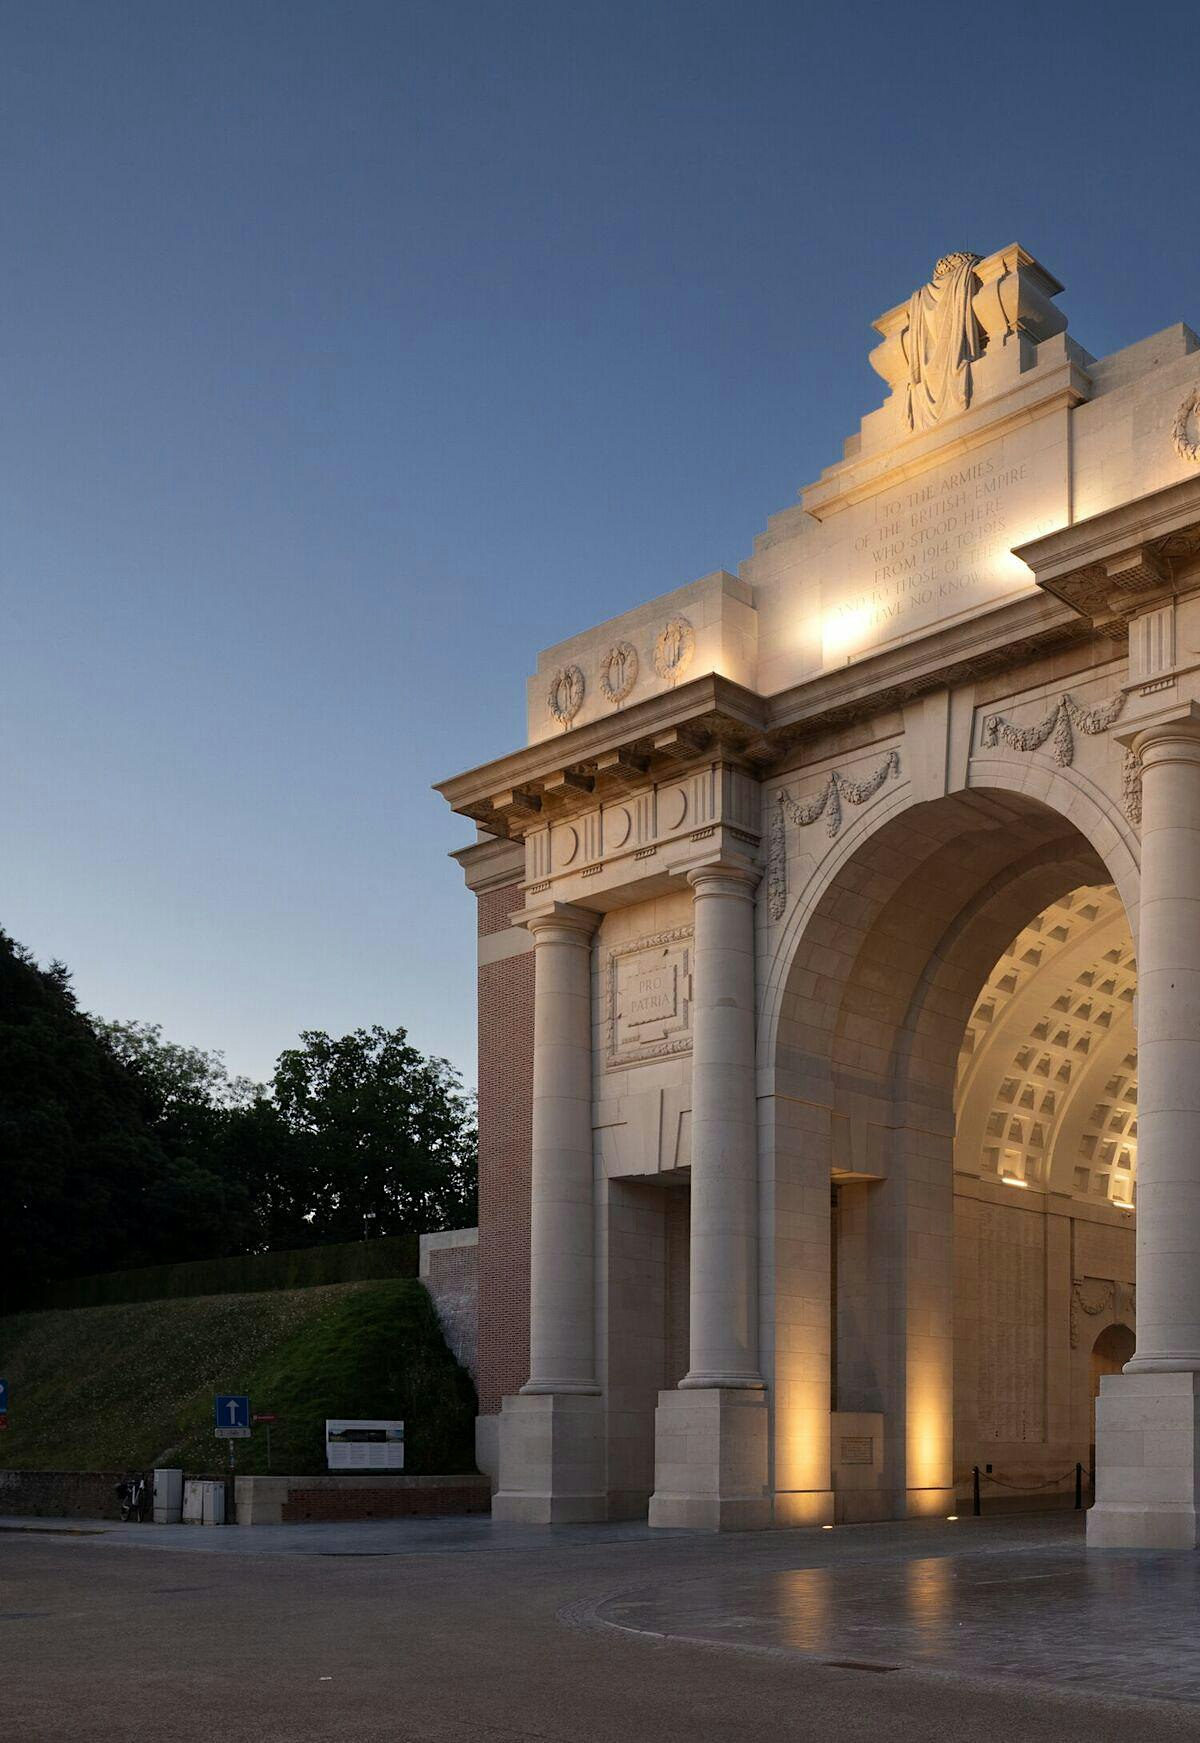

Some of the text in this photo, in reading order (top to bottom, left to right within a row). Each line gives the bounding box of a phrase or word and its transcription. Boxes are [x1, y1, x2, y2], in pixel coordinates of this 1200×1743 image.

[906, 484, 936, 508] THE
[941, 457, 994, 494] ARMIES
[854, 463, 1028, 551] OF THE BRITISH EMPIRE
[872, 496, 1004, 563] WHO STOOD HERE
[874, 554, 916, 584] FROM
[922, 539, 949, 564] 1914
[954, 530, 974, 549] TO
[978, 516, 1008, 540] 1918
[895, 566, 937, 595] THOSE
[944, 554, 961, 574] OF
[911, 588, 933, 608] NO
[631, 993, 671, 1013] PATRIA
[639, 977, 662, 993] PRO
